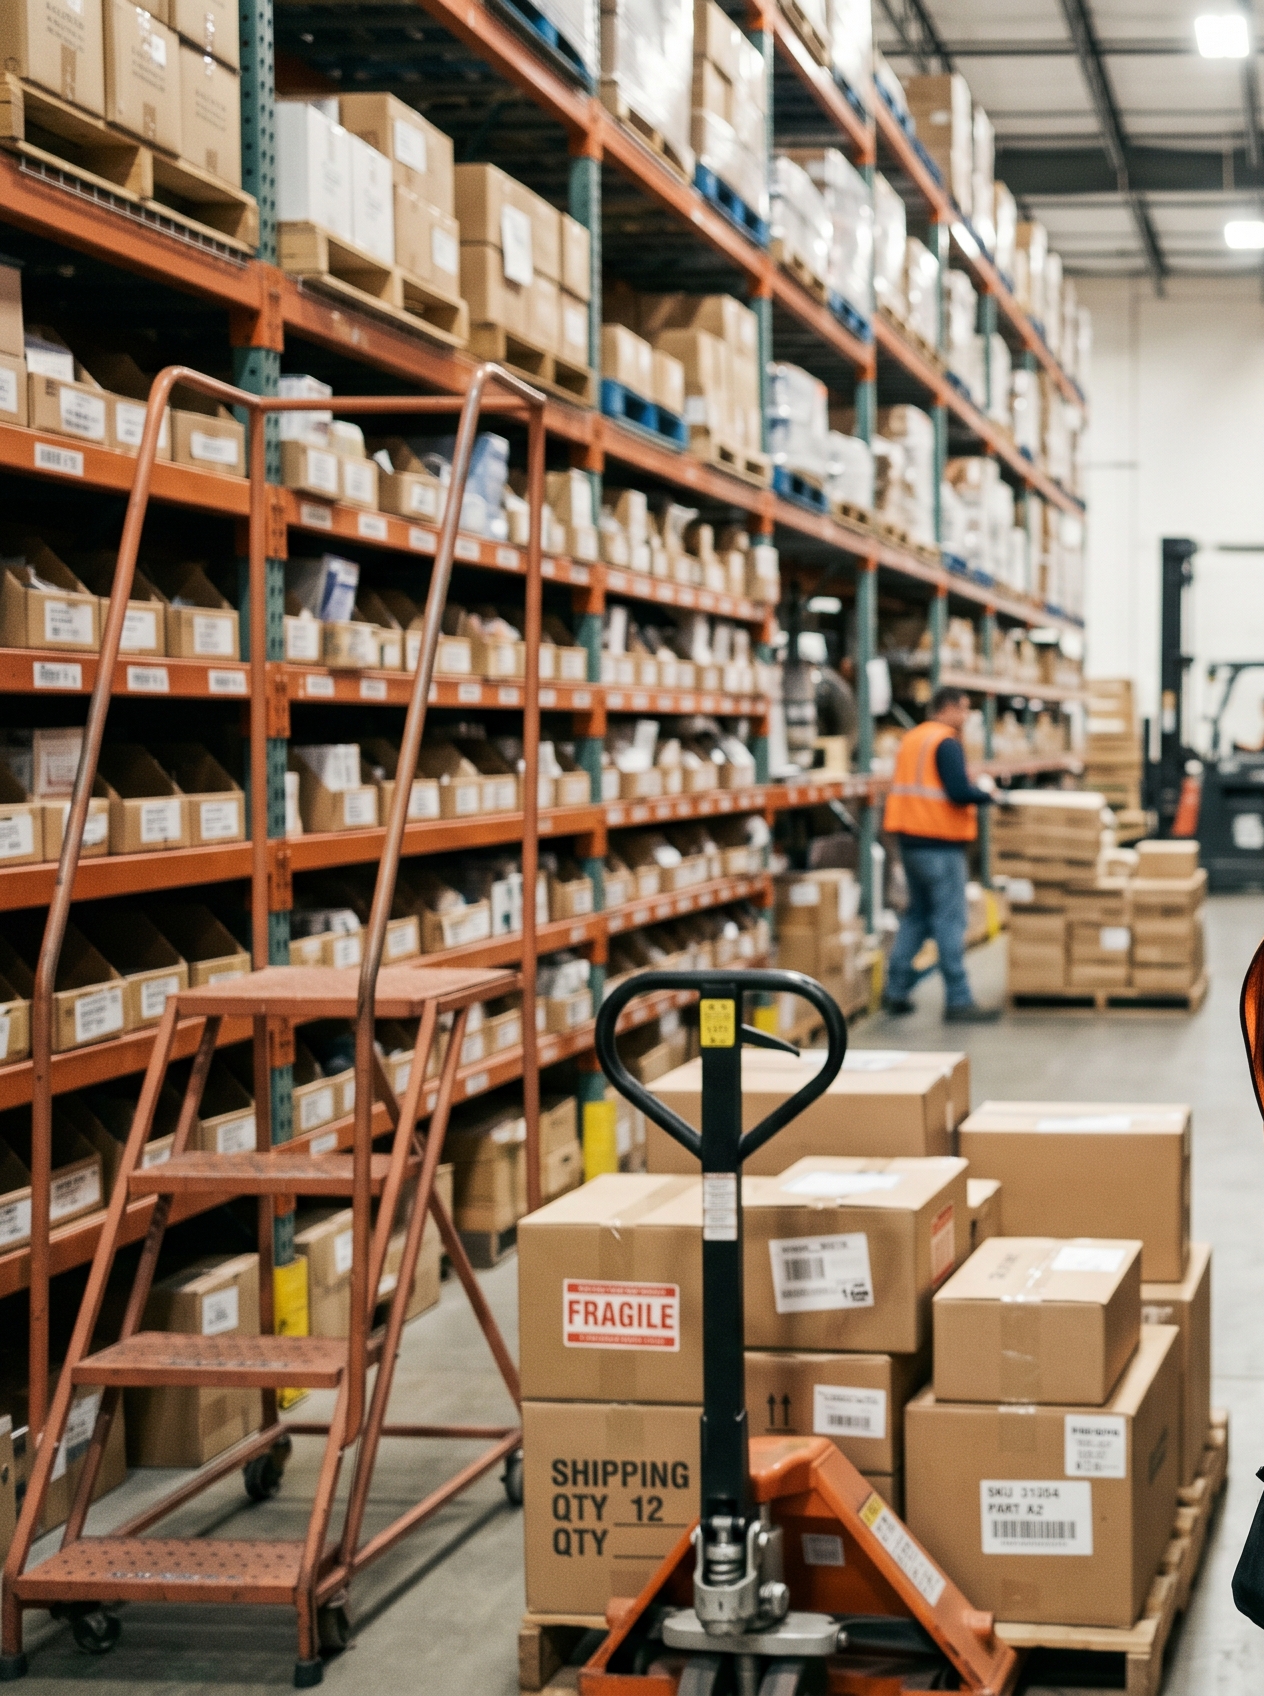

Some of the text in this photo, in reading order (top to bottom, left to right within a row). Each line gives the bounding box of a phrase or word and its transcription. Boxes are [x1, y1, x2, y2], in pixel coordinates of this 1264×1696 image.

[568, 1300, 674, 1329] FRAGILE
[552, 1458, 690, 1489] SHIPPING
[553, 1493, 664, 1523] QTY 12
[988, 1503, 1020, 1515] PART
[553, 1527, 609, 1558] QTY
